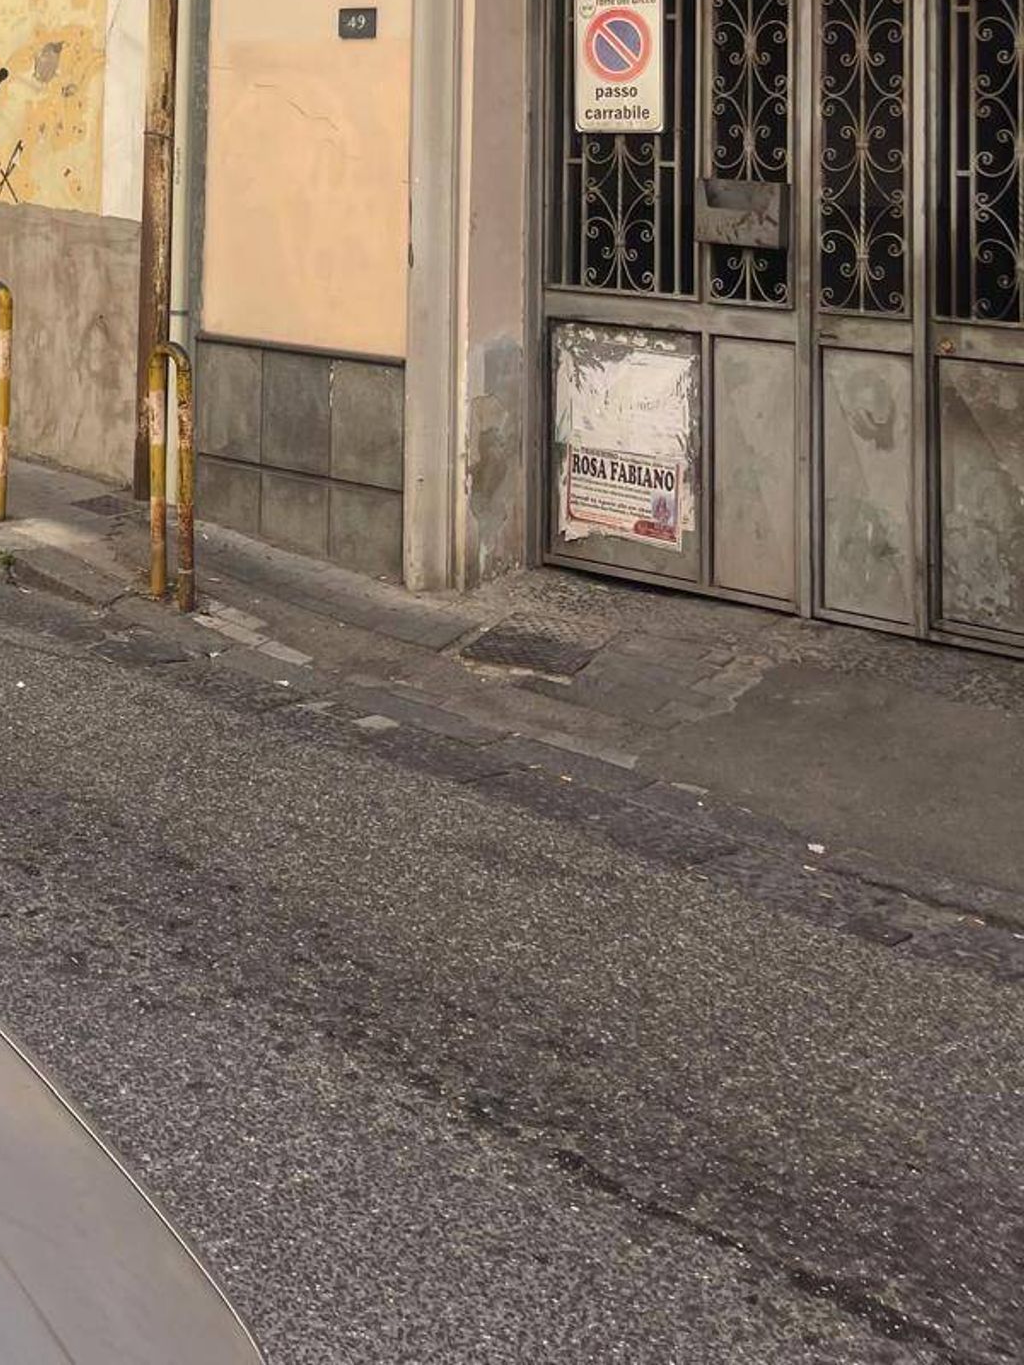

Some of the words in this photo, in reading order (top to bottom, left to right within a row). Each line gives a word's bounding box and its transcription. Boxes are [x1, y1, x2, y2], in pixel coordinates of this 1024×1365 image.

[347, 14, 366, 30] 49
[595, 86, 638, 101] passo
[585, 105, 650, 120] carrabile
[572, 454, 607, 479] ROSA
[611, 462, 674, 491] FABIANO
